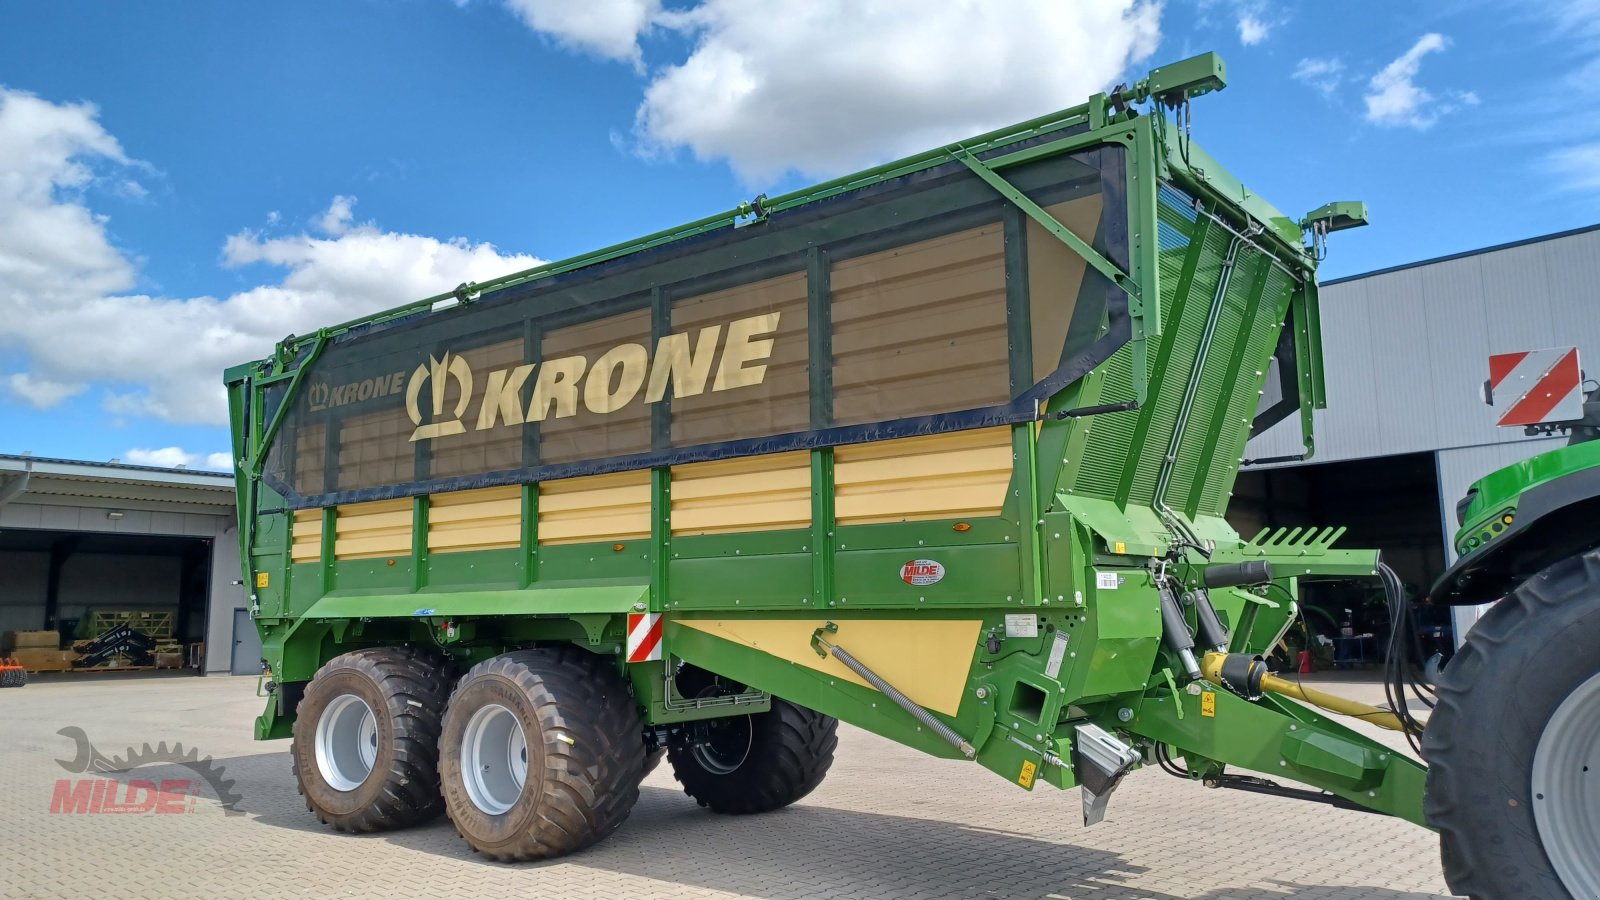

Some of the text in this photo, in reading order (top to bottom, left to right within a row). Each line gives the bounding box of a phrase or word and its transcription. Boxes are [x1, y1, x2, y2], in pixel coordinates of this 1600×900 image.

[328, 371, 406, 408] KRONE
[475, 311, 781, 431] KRONE
[904, 565, 937, 575] MILDE
